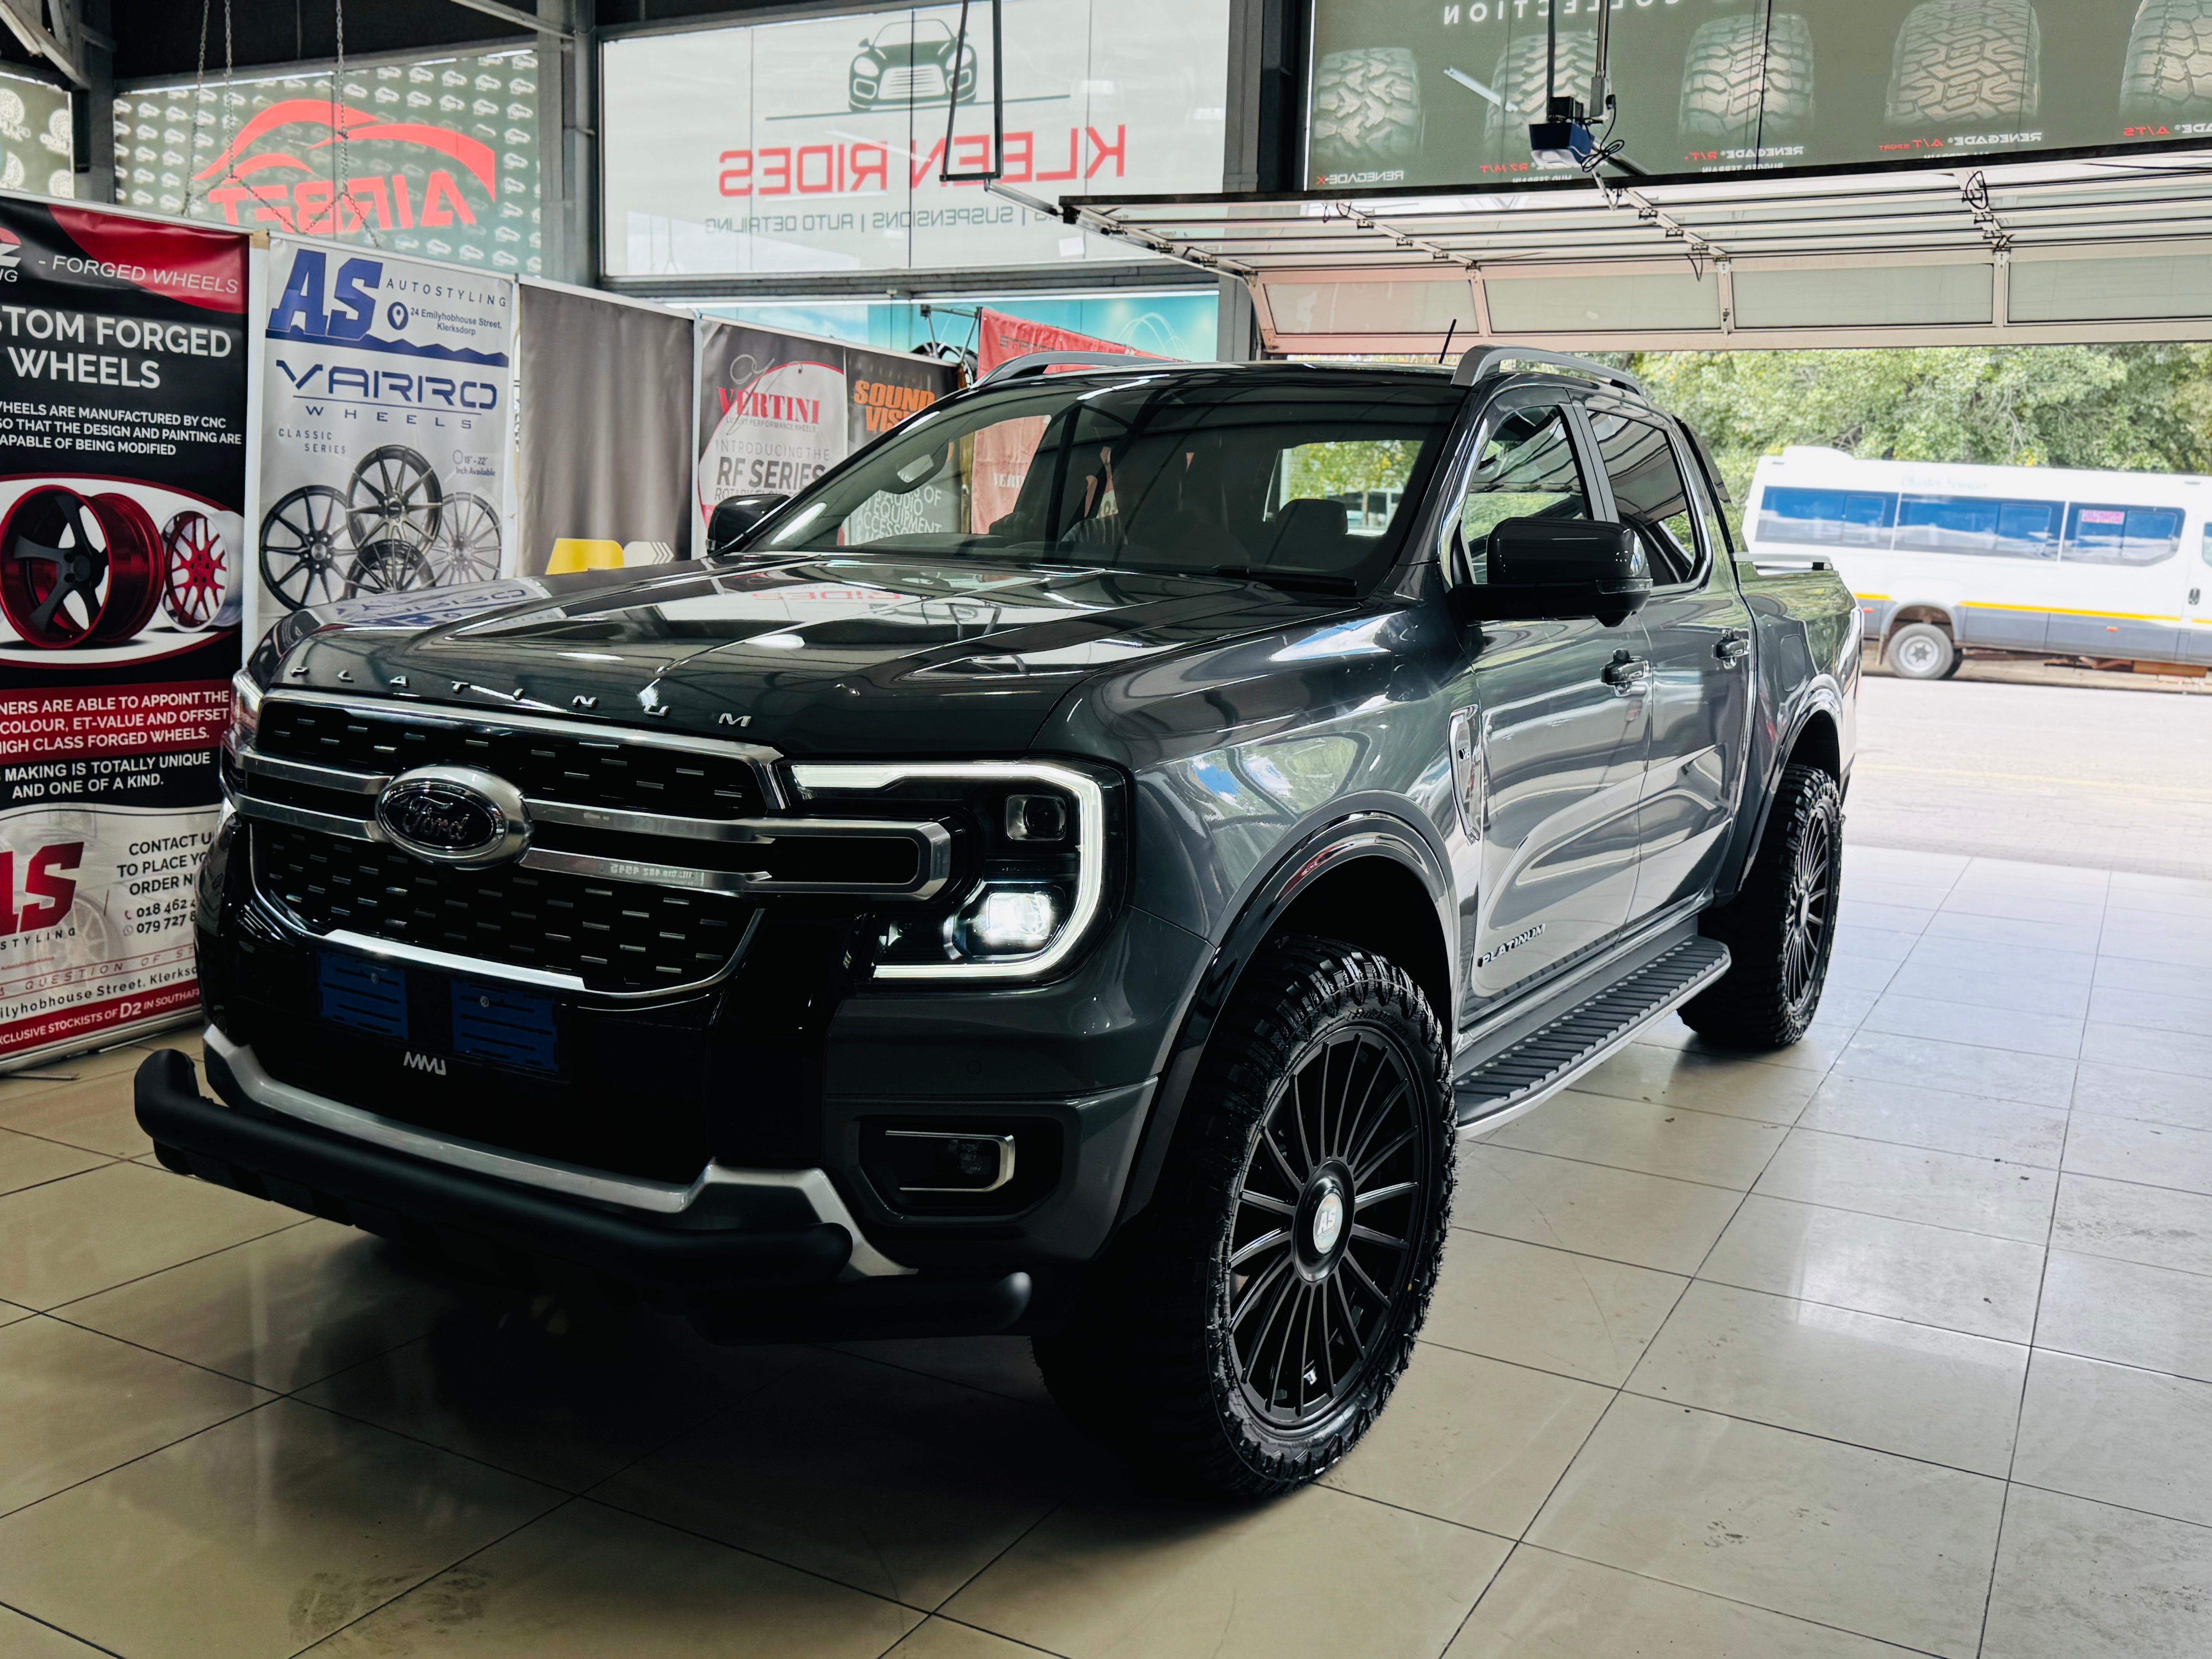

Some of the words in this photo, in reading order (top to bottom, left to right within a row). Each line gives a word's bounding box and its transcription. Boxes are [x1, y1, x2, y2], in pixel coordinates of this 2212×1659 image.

[52, 254, 146, 281] FORGED
[153, 269, 238, 293] WHEELS
[268, 249, 383, 341] AS
[386, 278, 506, 307] AUTOSTYLING
[411, 307, 419, 316] 24
[421, 309, 477, 325] Emilyhobhouse
[437, 322, 476, 337] Klerksdorp
[0, 306, 84, 343] TOM
[96, 316, 231, 357] FORGED
[7, 347, 160, 388] WHEELS
[276, 359, 497, 409] VARRO
[854, 380, 935, 412] SOUND
[0, 401, 47, 416] HEELS
[49, 405, 76, 418] ARE
[79, 407, 181, 425] MANUFACTURED
[183, 415, 199, 426] BY
[201, 416, 226, 428] CNC
[306, 405, 472, 429] WHEELS
[718, 386, 820, 424] VERTINI
[15, 418, 52, 432] THAT
[54, 421, 81, 434] THE
[84, 423, 131, 438] DESIGN
[133, 427, 159, 439] AND
[162, 429, 217, 443] PAINTING
[219, 433, 242, 445] ARE
[279, 428, 333, 441] CLASSIC
[750, 419, 793, 431] PERFORMANCE
[54, 438, 73, 449] OF
[76, 438, 115, 452] BEING
[118, 441, 176, 455] MODIFIED
[304, 443, 346, 455] SERIES
[716, 439, 802, 458] INTRODUCING
[804, 447, 830, 461] THE
[717, 457, 745, 486] RF
[924, 486, 942, 506] OF
[41, 699, 73, 713] ARE
[76, 697, 116, 711] ABLE
[118, 696, 139, 709] TO
[141, 692, 201, 708] APPOINT
[203, 690, 229, 704] THE
[290, 666, 752, 728] PLATINUM
[0, 718, 69, 735] COLOUR,
[73, 713, 144, 730] ET-VALUE
[146, 711, 177, 726] AND
[179, 708, 229, 723] OFFSET
[33, 735, 84, 751] CLASS
[88, 732, 148, 748] FORGED
[150, 726, 210, 743] WHEELS.
[5, 764, 67, 782] MAKING
[72, 762, 86, 775] IS
[91, 757, 155, 775] TOTALLY
[159, 751, 211, 768] UNIQUE
[12, 783, 45, 799] AND
[49, 780, 83, 794] ONE
[88, 778, 109, 792] OF
[112, 777, 124, 790] A
[127, 773, 164, 788] KIND.
[402, 796, 470, 841] Ford
[129, 834, 198, 855] CONTACT
[201, 832, 214, 845] U
[117, 864, 138, 878] TO
[143, 855, 187, 874] PLACE
[129, 876, 179, 895] ORDER
[136, 903, 161, 917] 018
[164, 898, 187, 914] 462
[136, 920, 160, 933] 079
[164, 914, 187, 930] 727
[1477, 923, 1546, 967] PLATINUM
[25, 962, 123, 990] QUESTION
[141, 954, 160, 967] OF
[48, 1013, 103, 1033] STOCKISTS
[105, 1009, 118, 1020] OF
[120, 1001, 141, 1019] D2
[144, 1001, 154, 1010] IN
[1317, 1206, 1337, 1235] AS
